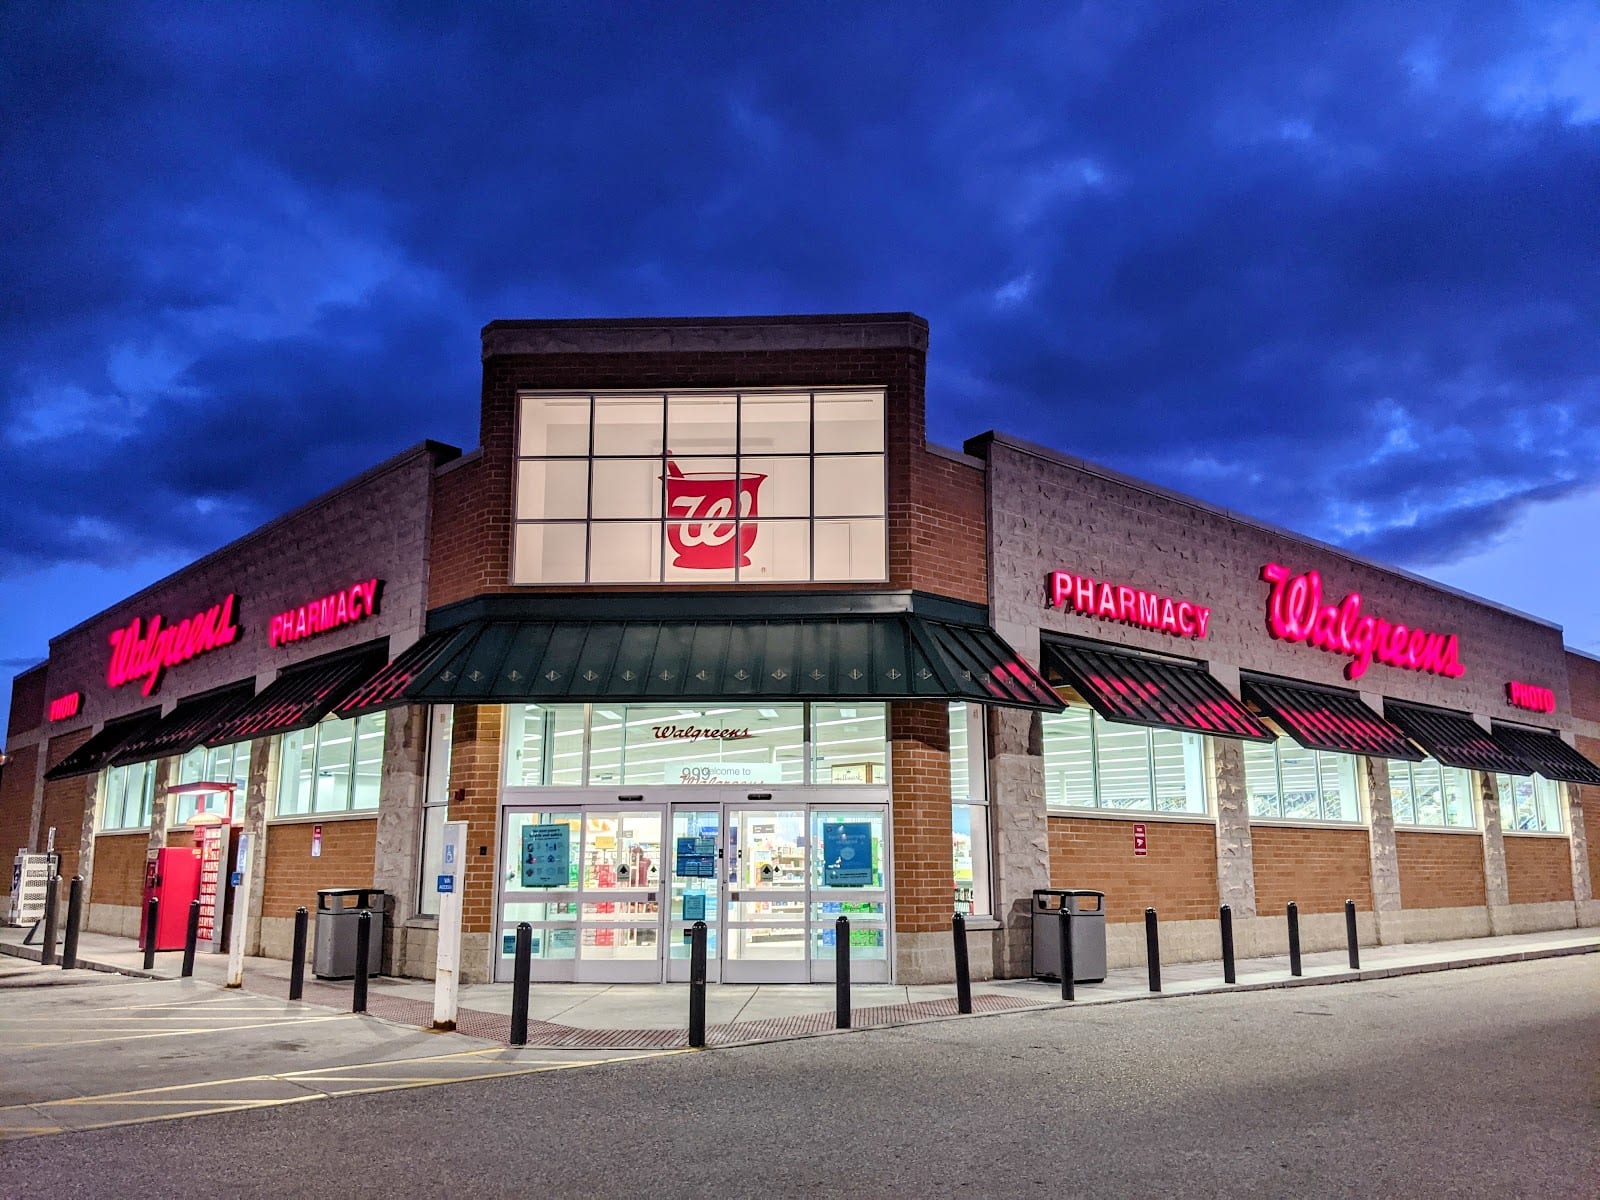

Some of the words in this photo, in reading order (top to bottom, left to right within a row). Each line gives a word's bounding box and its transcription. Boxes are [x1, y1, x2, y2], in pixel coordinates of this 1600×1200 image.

[270, 578, 378, 648] PHARMACY
[1053, 572, 1210, 638] PHARMACY
[1261, 563, 1465, 680] Walgreens
[108, 593, 237, 697] Walgreens
[49, 691, 79, 721] PHOTO
[1511, 680, 1556, 714] PHOTO
[652, 725, 752, 742] Walgreens
[681, 767, 711, 781] 999
[742, 767, 751, 776] to
